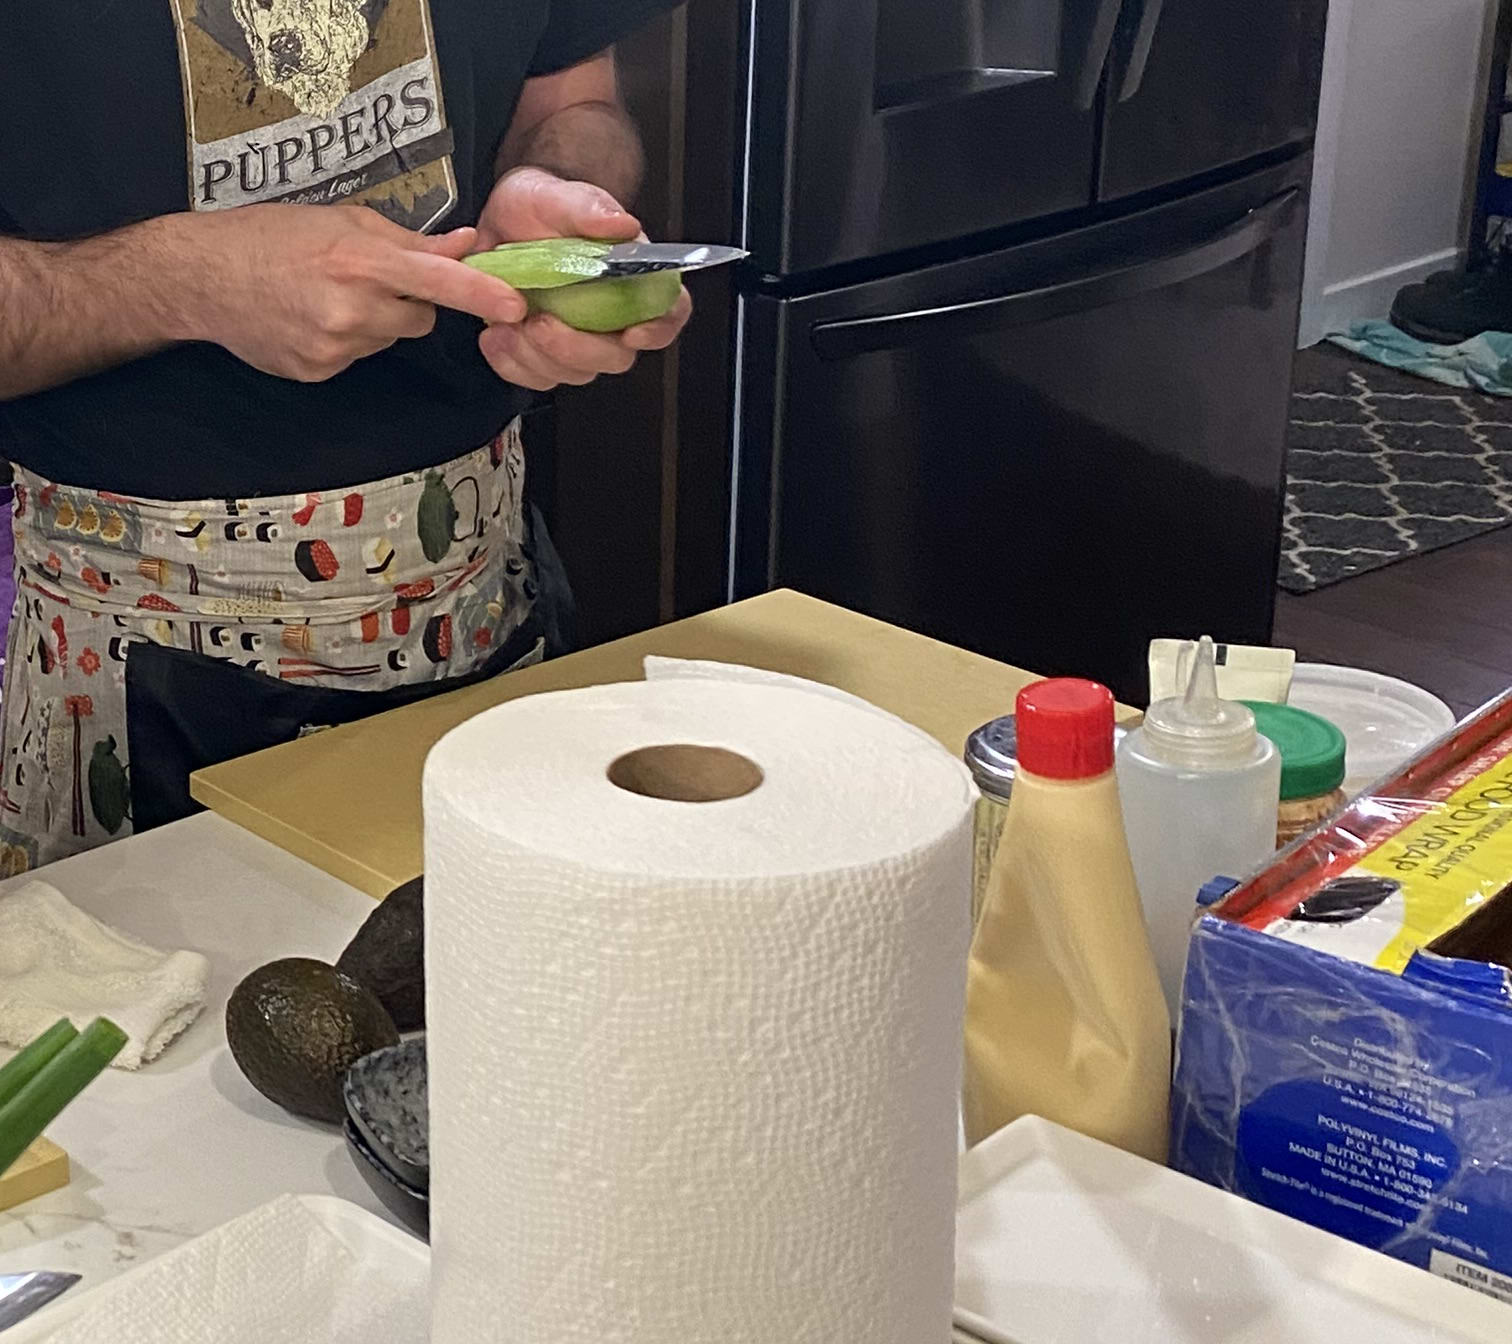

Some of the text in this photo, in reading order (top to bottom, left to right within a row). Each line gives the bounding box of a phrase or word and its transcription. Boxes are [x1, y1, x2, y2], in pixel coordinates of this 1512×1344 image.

[199, 76, 434, 205] PUPPERS
[328, 173, 368, 197] Lager
[1388, 825, 1471, 872] WRAP
[1317, 1113, 1380, 1146] POLYVINYL
[1289, 1141, 1322, 1162] MADE
[1324, 1154, 1337, 1168] IN
[1371, 1145, 1393, 1163] Box
[1378, 1161, 1397, 1177] MA
[1454, 1262, 1489, 1285] ITEM
